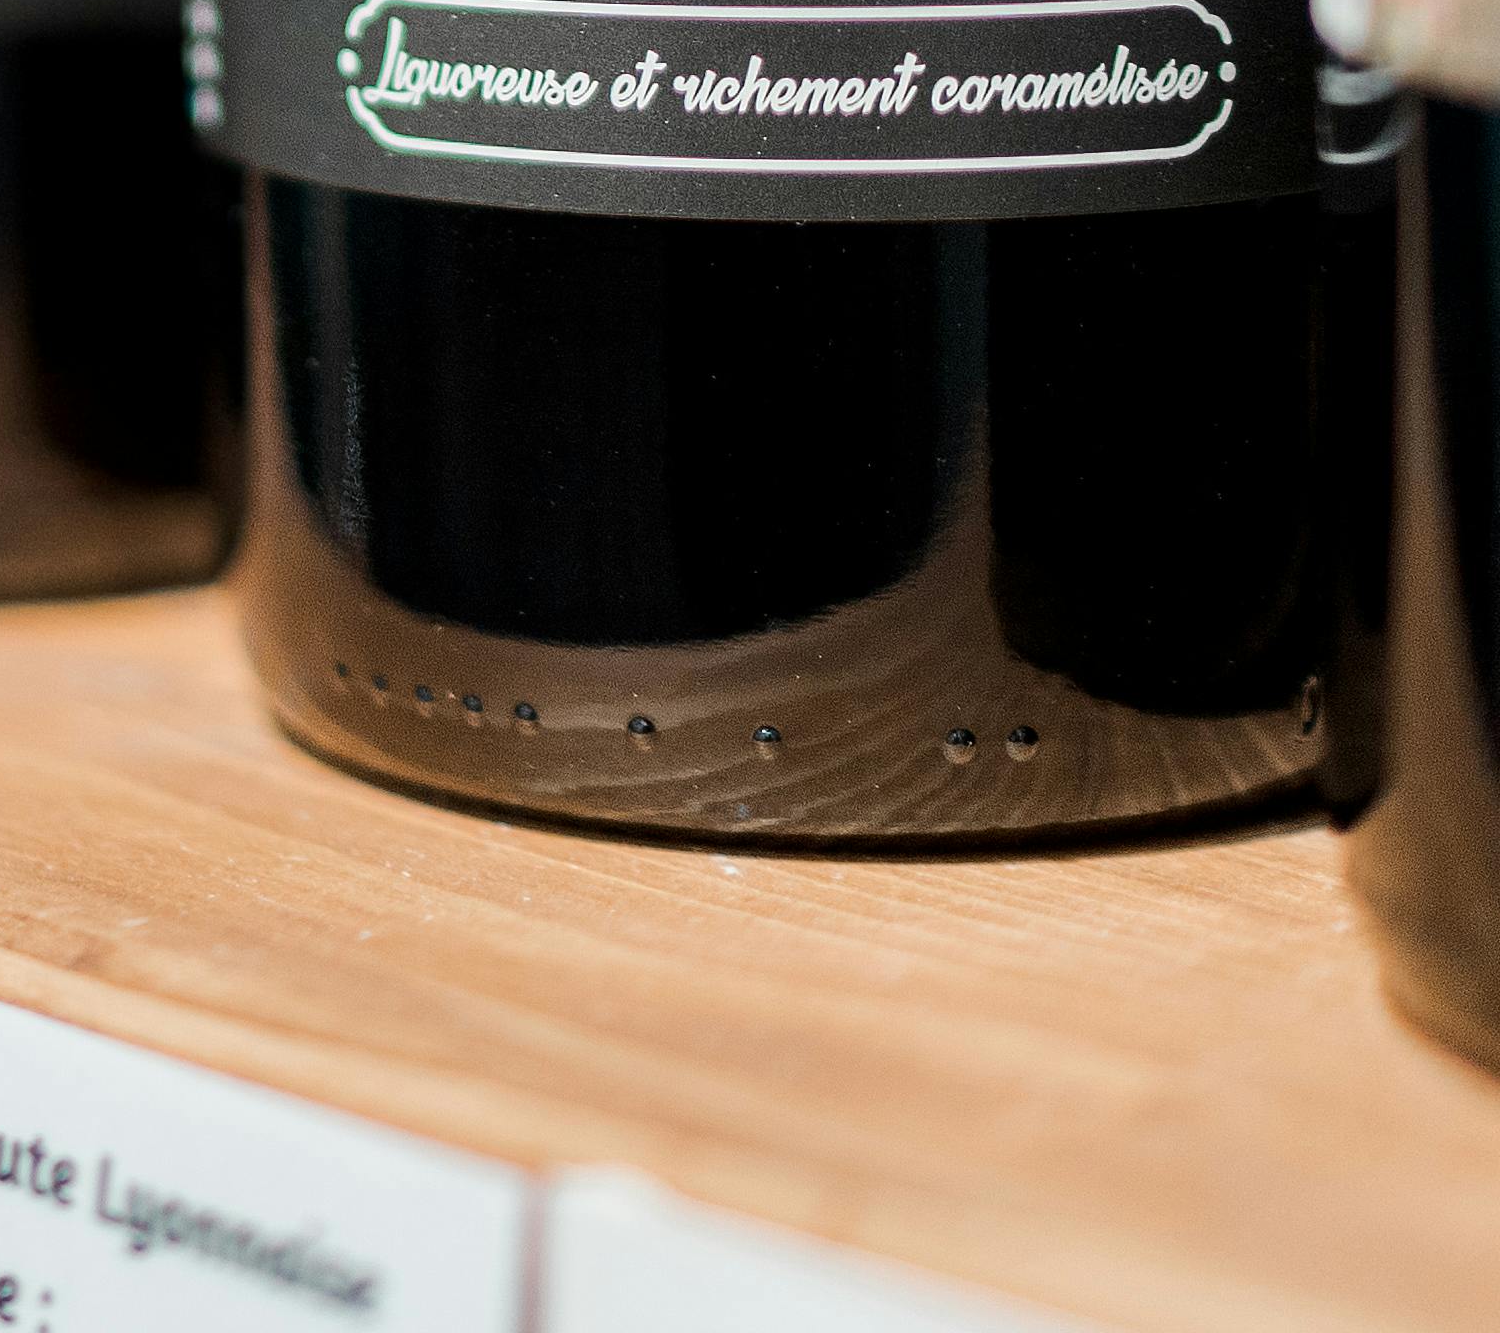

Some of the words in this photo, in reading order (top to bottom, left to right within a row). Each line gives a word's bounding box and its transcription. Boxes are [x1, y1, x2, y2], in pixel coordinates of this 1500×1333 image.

[364, 16, 598, 108] Liquoreuse
[609, 49, 667, 110] et
[673, 53, 925, 115] richement
[930, 45, 1206, 114] caramélisée
